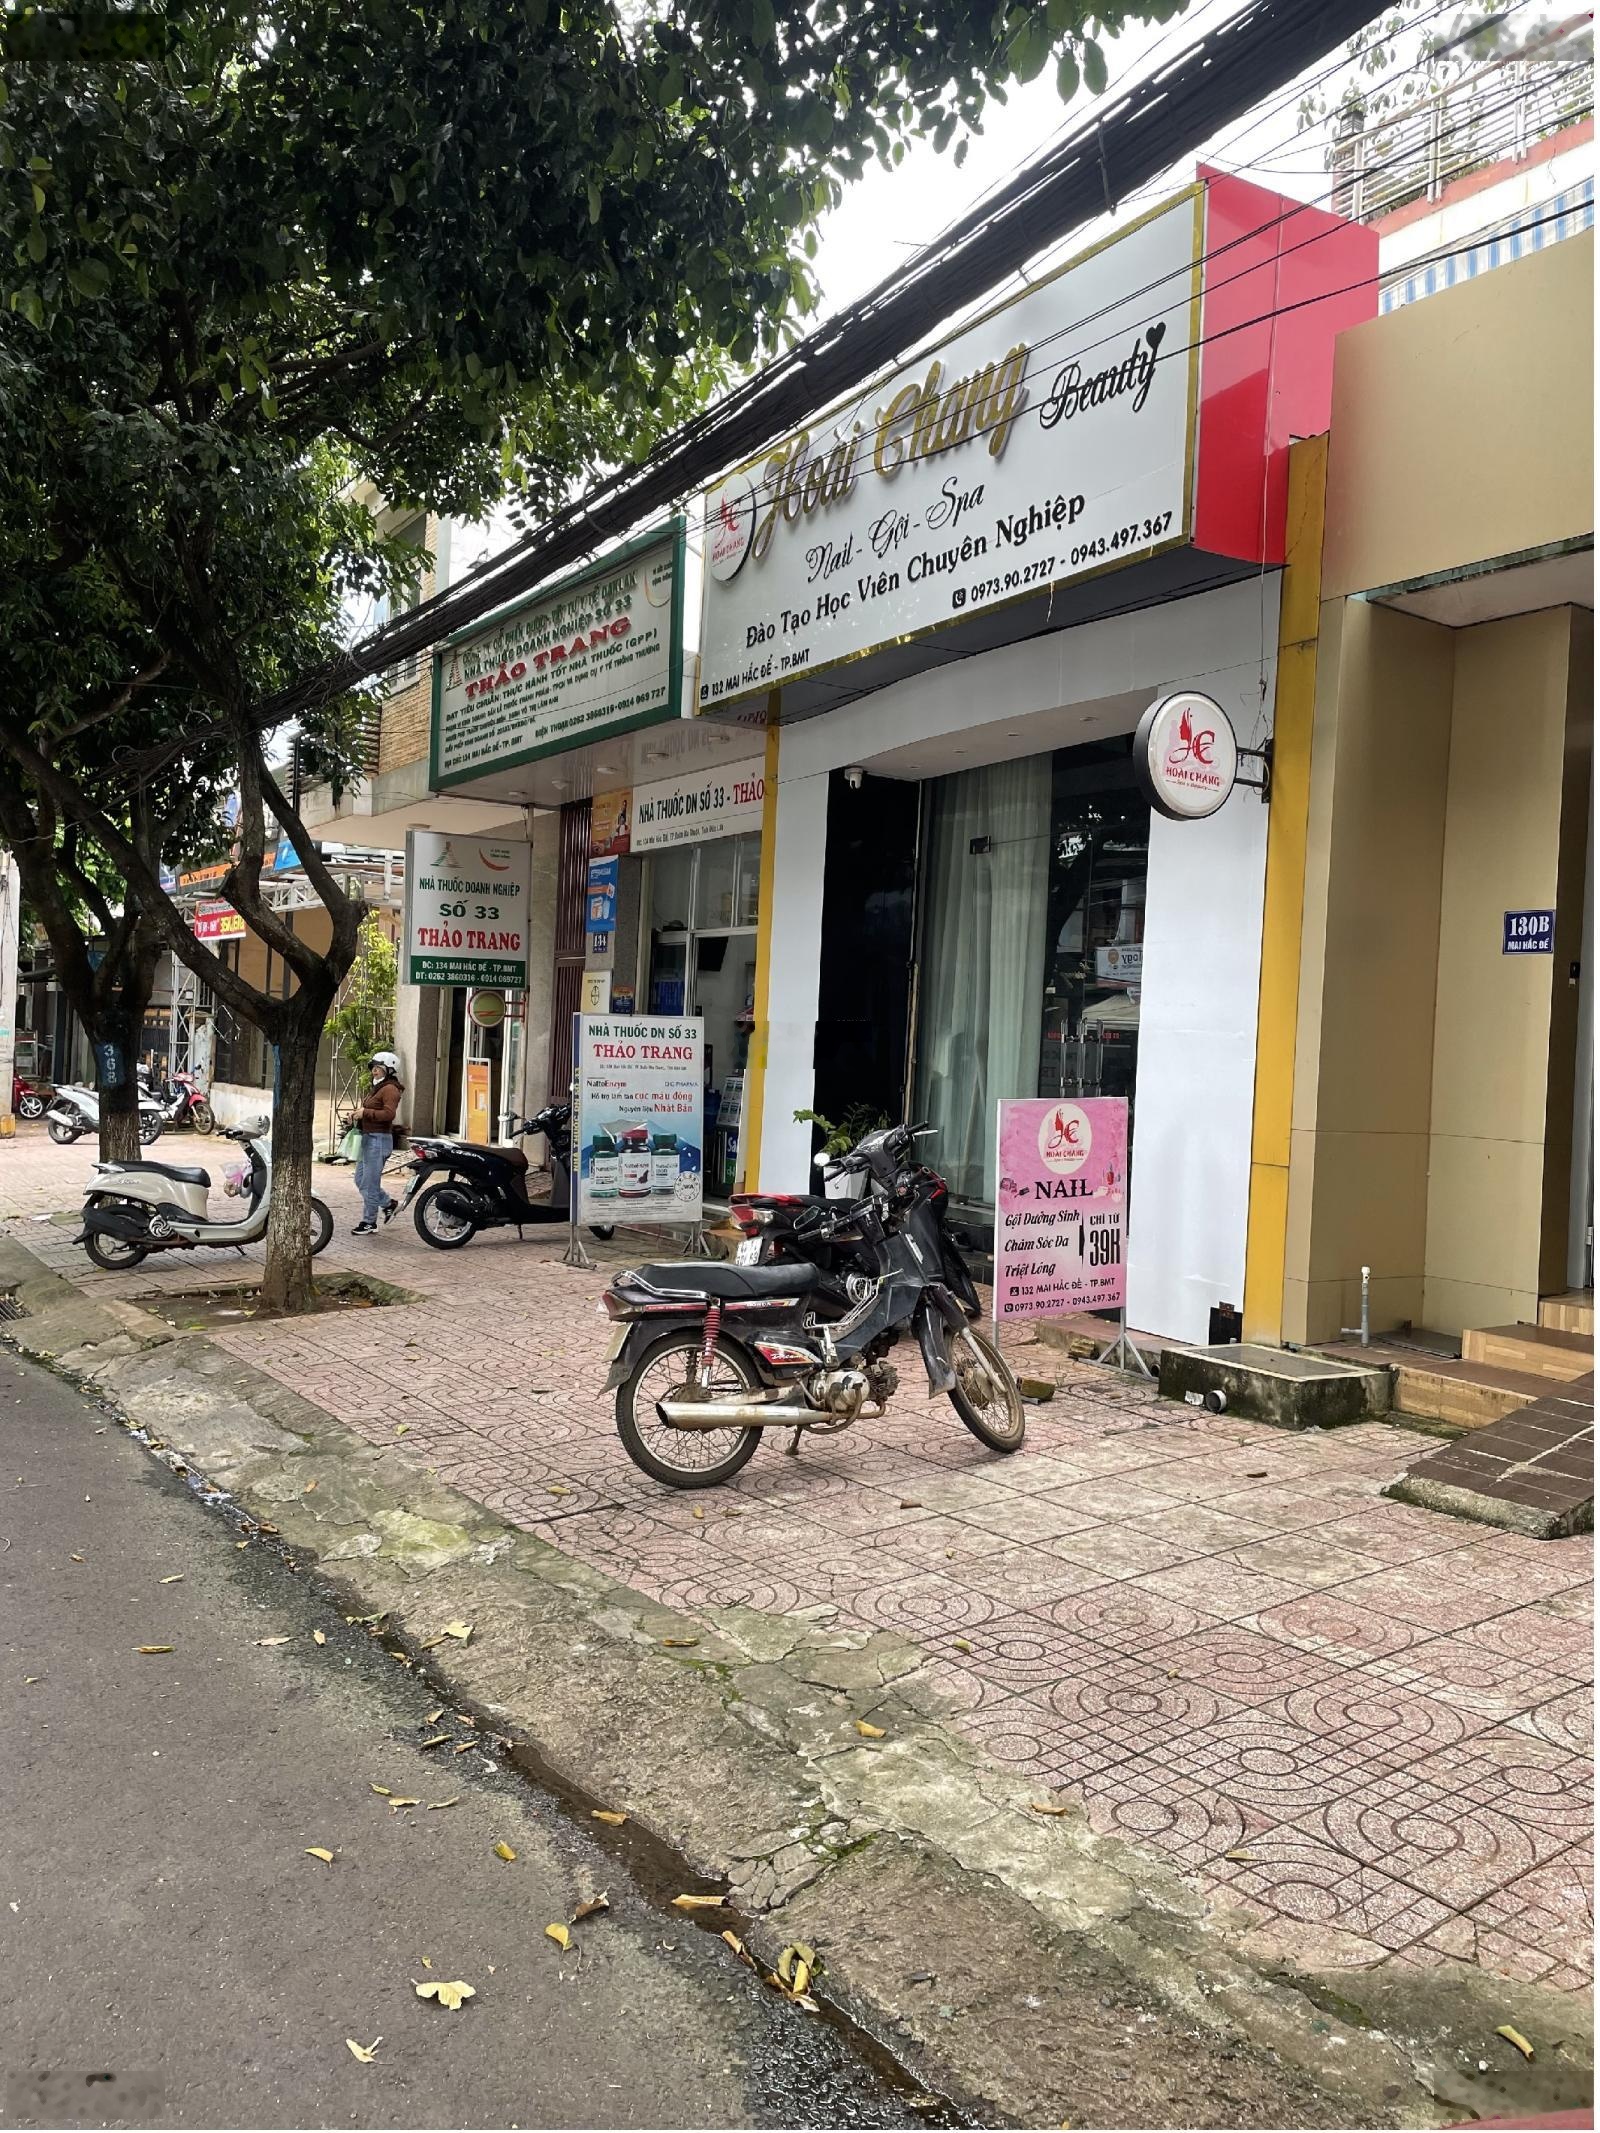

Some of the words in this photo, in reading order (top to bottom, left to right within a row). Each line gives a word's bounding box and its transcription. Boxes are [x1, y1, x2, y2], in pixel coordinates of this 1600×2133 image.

[874, 343, 1028, 477] Chang
[1040, 322, 1166, 429] Beauty
[805, 531, 853, 583] Nail
[868, 509, 909, 559] Gội
[926, 476, 985, 530] Spa
[971, 557, 1055, 601] 0973.90.2727
[1070, 511, 1172, 565] 0943.497.367
[746, 622, 776, 649] Đào
[781, 609, 811, 636] Tạo
[816, 592, 850, 620] Học
[858, 571, 899, 602] Viên
[907, 535, 987, 583] Chuyên
[995, 494, 1086, 548] Nghiệp
[516, 633, 551, 657] DOANH
[552, 612, 593, 640] NGHIỆP
[615, 594, 632, 613] 33
[465, 661, 527, 697] THẢO
[533, 616, 631, 670] TRANG
[569, 656, 587, 672] NHÀ
[591, 642, 623, 662] THUỐC
[712, 681, 723, 697] 132
[725, 674, 739, 692] MAI
[742, 662, 758, 684] HẮC
[761, 654, 773, 678] ĐẾ
[781, 648, 810, 671] TP.BMT
[639, 797, 654, 824] NHÀ
[657, 788, 684, 820] THUỐC
[686, 793, 697, 815] DN
[700, 780, 712, 811] SỐ
[713, 786, 724, 809] 33
[733, 772, 764, 805] THẢO
[419, 875, 435, 890] NHÀ
[437, 876, 464, 893] THUỐC
[465, 881, 490, 895] DOANH
[492, 882, 521, 899] NGHIỆP
[439, 900, 467, 918] SỐ
[474, 905, 499, 920] 33
[418, 920, 463, 948] THẢO
[467, 929, 521, 951] TRANG
[1509, 915, 1550, 936] 130B
[1507, 941, 1522, 951] MAI
[1522, 938, 1538, 950] HẮC
[1539, 937, 1550, 949] ĐẾ
[435, 961, 448, 969] 134
[449, 962, 462, 970] MAI
[588, 1022, 610, 1037] NHÀ
[613, 1022, 648, 1038] THUỐC
[650, 1027, 665, 1039] DN
[668, 1024, 682, 1039] SỐ
[684, 1028, 697, 1039] 33
[593, 1040, 636, 1059] THẢO
[641, 1045, 693, 1060] TRANG
[1034, 1178, 1094, 1200] NAIL
[1005, 1213, 1021, 1229] Gội
[1023, 1211, 1056, 1226] Dưỡng
[1057, 1209, 1080, 1222] Sinh
[1036, 1236, 1054, 1249] Sóc
[1055, 1235, 1069, 1248] Da
[1005, 1262, 1029, 1279] Triệt
[1021, 1286, 1034, 1296] 132
[1036, 1284, 1051, 1295] MAI
[1053, 1279, 1070, 1291] HẮC
[1090, 1278, 1116, 1288] TP.BMT
[1014, 1298, 1065, 1312] 0973.90.2727
[1072, 1292, 1121, 1306] 0943.497.367
